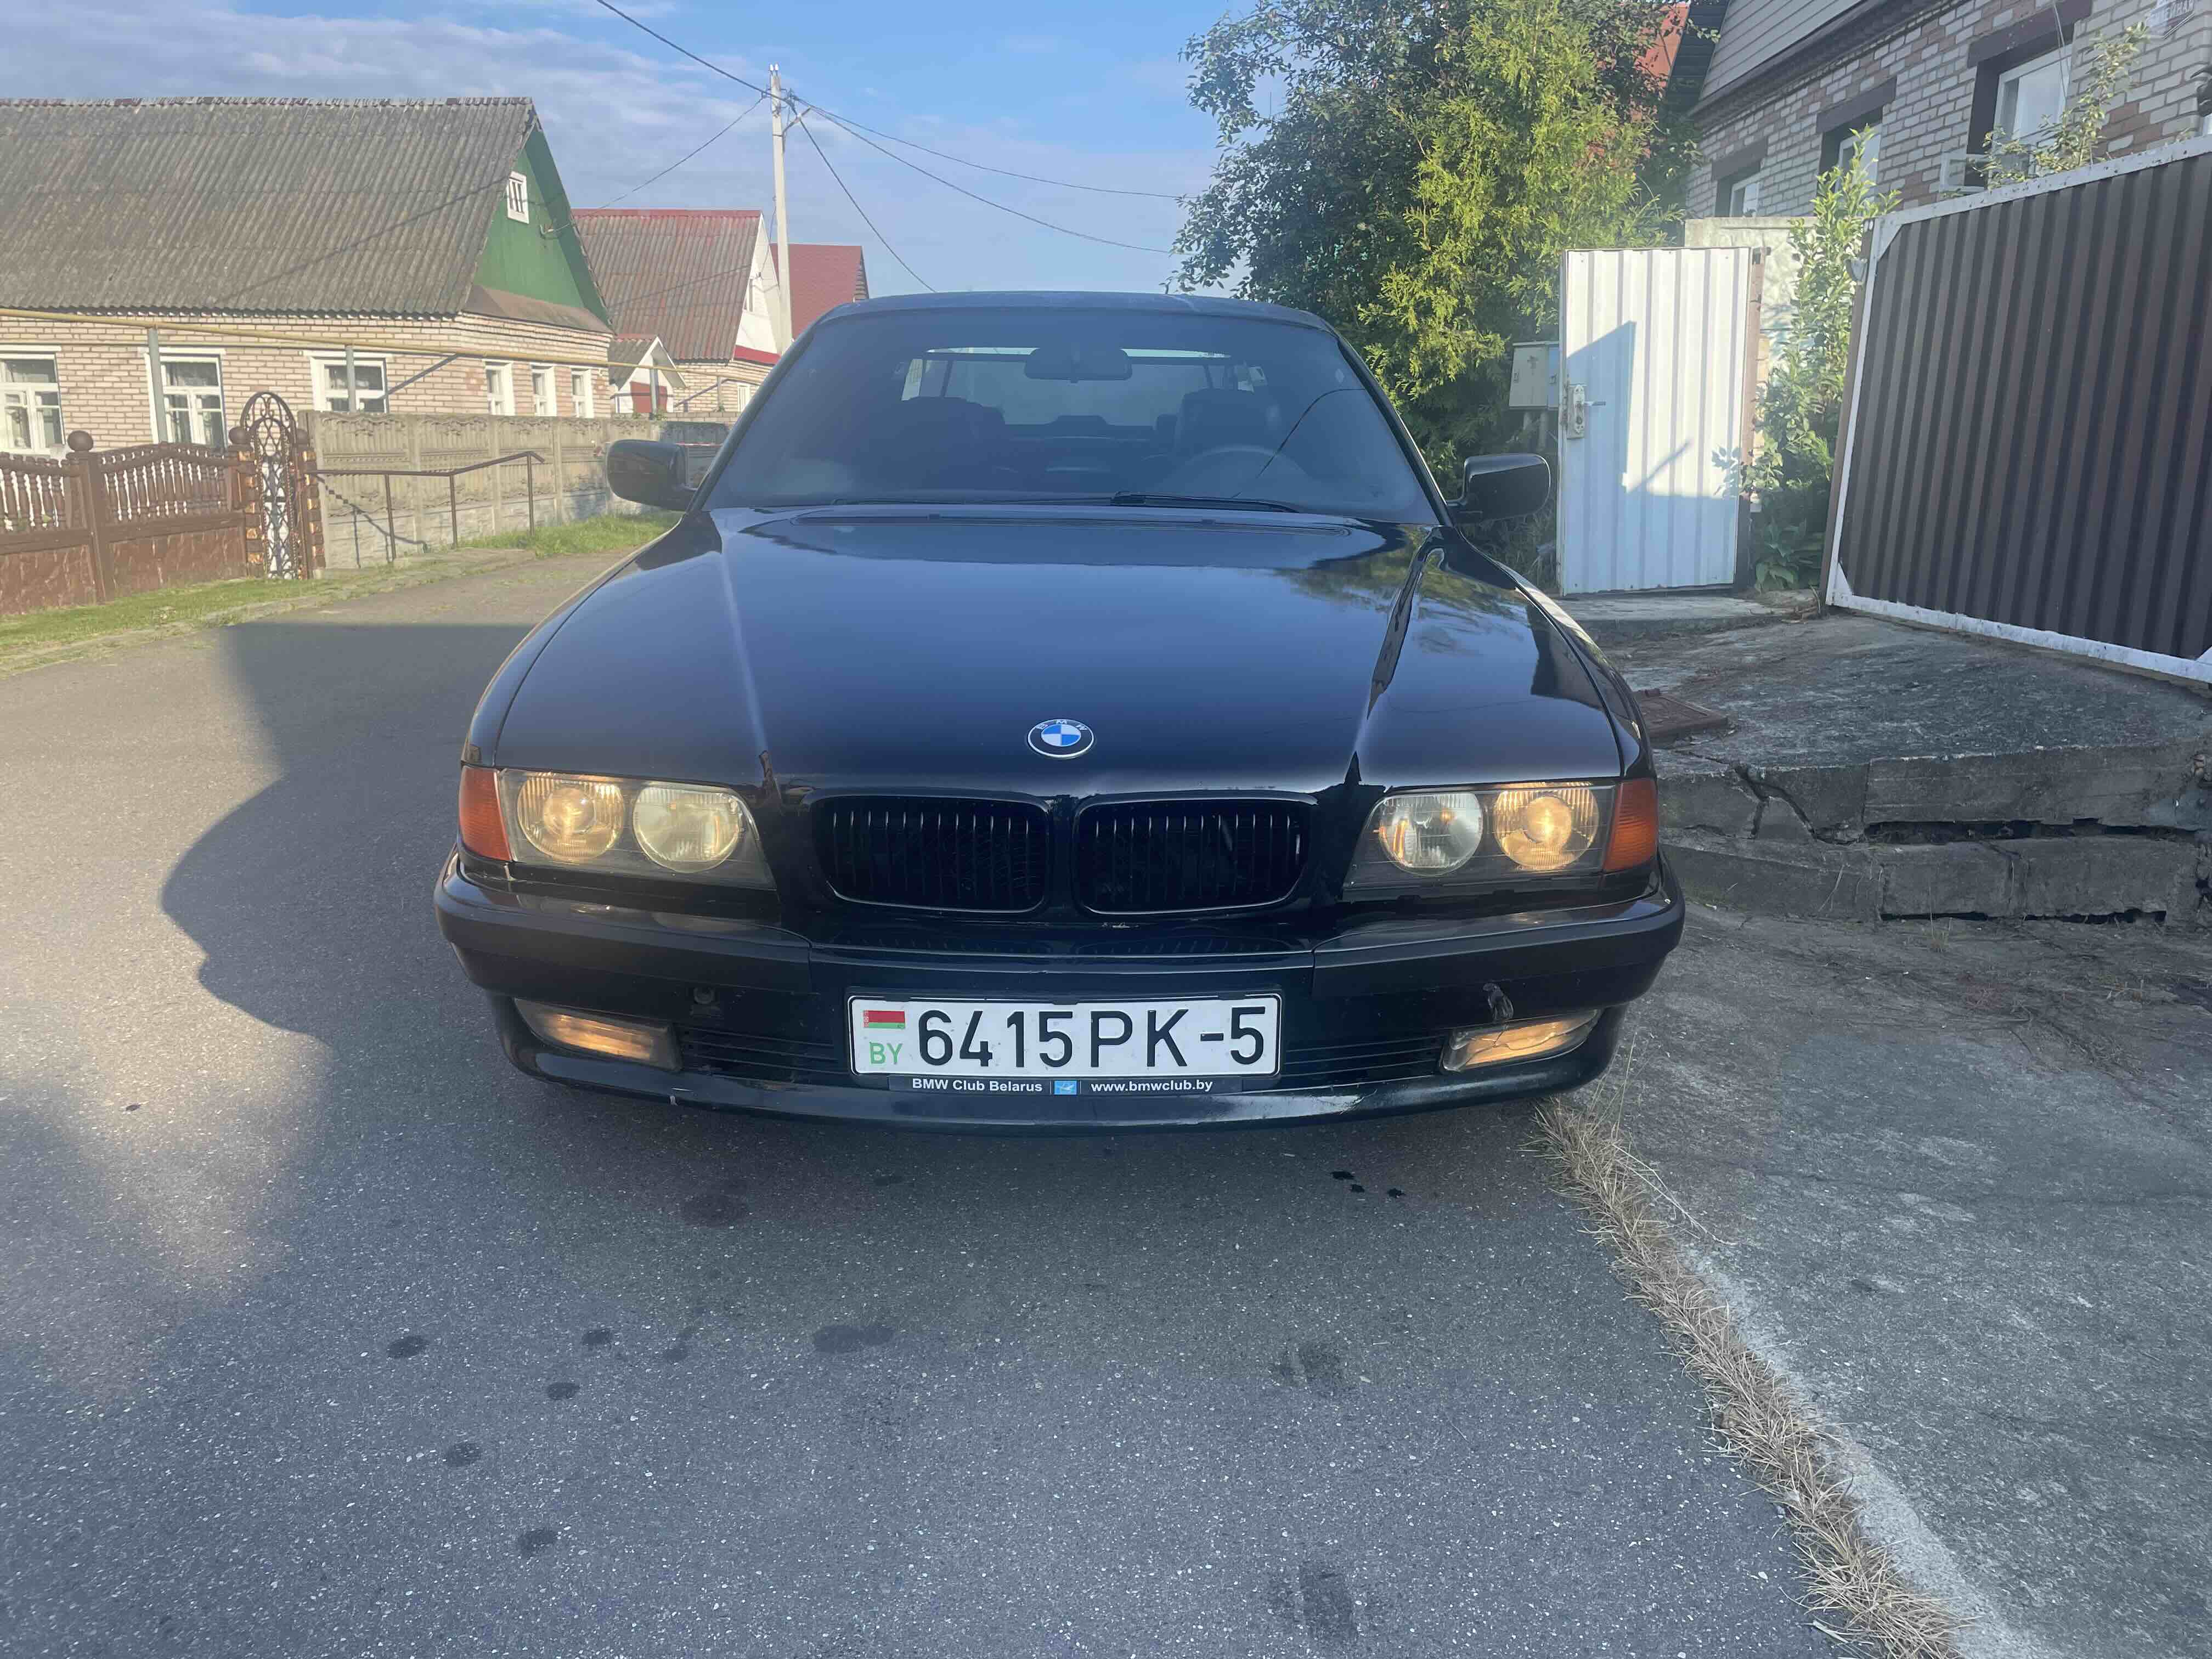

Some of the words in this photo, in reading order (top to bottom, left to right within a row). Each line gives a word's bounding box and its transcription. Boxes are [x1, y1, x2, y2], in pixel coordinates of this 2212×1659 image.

[869, 1041, 904, 1065] BY
[912, 1077, 949, 1090] BMW
[952, 1079, 985, 1092] Club
[989, 1080, 1043, 1092] Belarus
[1091, 1079, 1213, 1092] www.bmwclub.by
